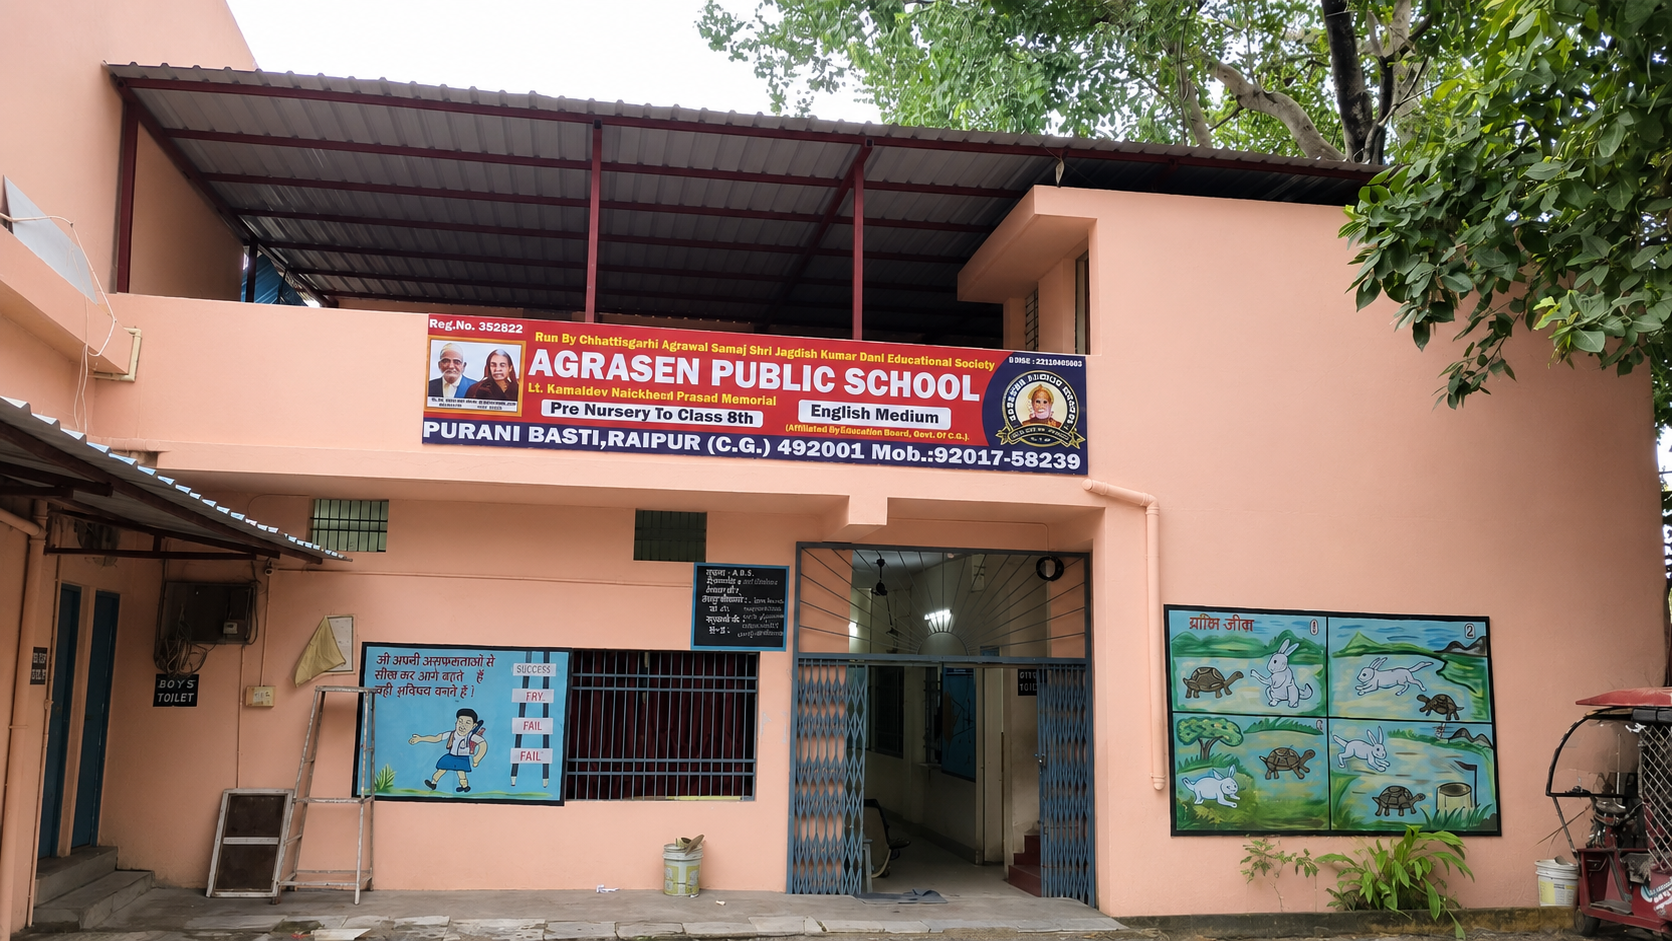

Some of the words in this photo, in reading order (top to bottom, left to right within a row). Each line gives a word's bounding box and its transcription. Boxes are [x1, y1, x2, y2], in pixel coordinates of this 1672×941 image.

[429, 319, 475, 331] Reg.No.
[479, 322, 523, 334] 352822
[535, 332, 558, 342] Run
[562, 333, 576, 345] By
[579, 335, 659, 349] Chhattisgarhi
[662, 340, 708, 352] Agrawal
[711, 343, 747, 356] Samaj
[749, 345, 772, 356] Shri
[775, 347, 818, 361] Jagdish
[820, 350, 857, 360] Kumar
[888, 354, 952, 367] Educational
[954, 358, 995, 372] Society
[528, 348, 700, 386] AGRASEN
[711, 358, 836, 393] PUBLIC
[844, 368, 980, 402] SCHOOL
[528, 382, 543, 394] Lt.
[547, 383, 608, 397] Kamaldev
[677, 391, 718, 404] Prasad
[722, 394, 776, 406] Memorial
[550, 401, 580, 415] Pre
[584, 404, 650, 421] Nursery
[655, 406, 674, 420] To
[678, 408, 723, 424] Class
[727, 411, 754, 424] 8th
[811, 404, 870, 422] English
[876, 406, 939, 424] Medium
[422, 421, 520, 442] PURANI
[707, 436, 770, 458] (C.G.)
[777, 438, 865, 460] 492001
[1466, 625, 1473, 637] 2
[516, 665, 550, 674] SUCCESS
[158, 680, 196, 688] BOYS
[158, 692, 194, 702] TOILET
[523, 721, 542, 730] FAIL
[520, 751, 541, 761] FAIL
